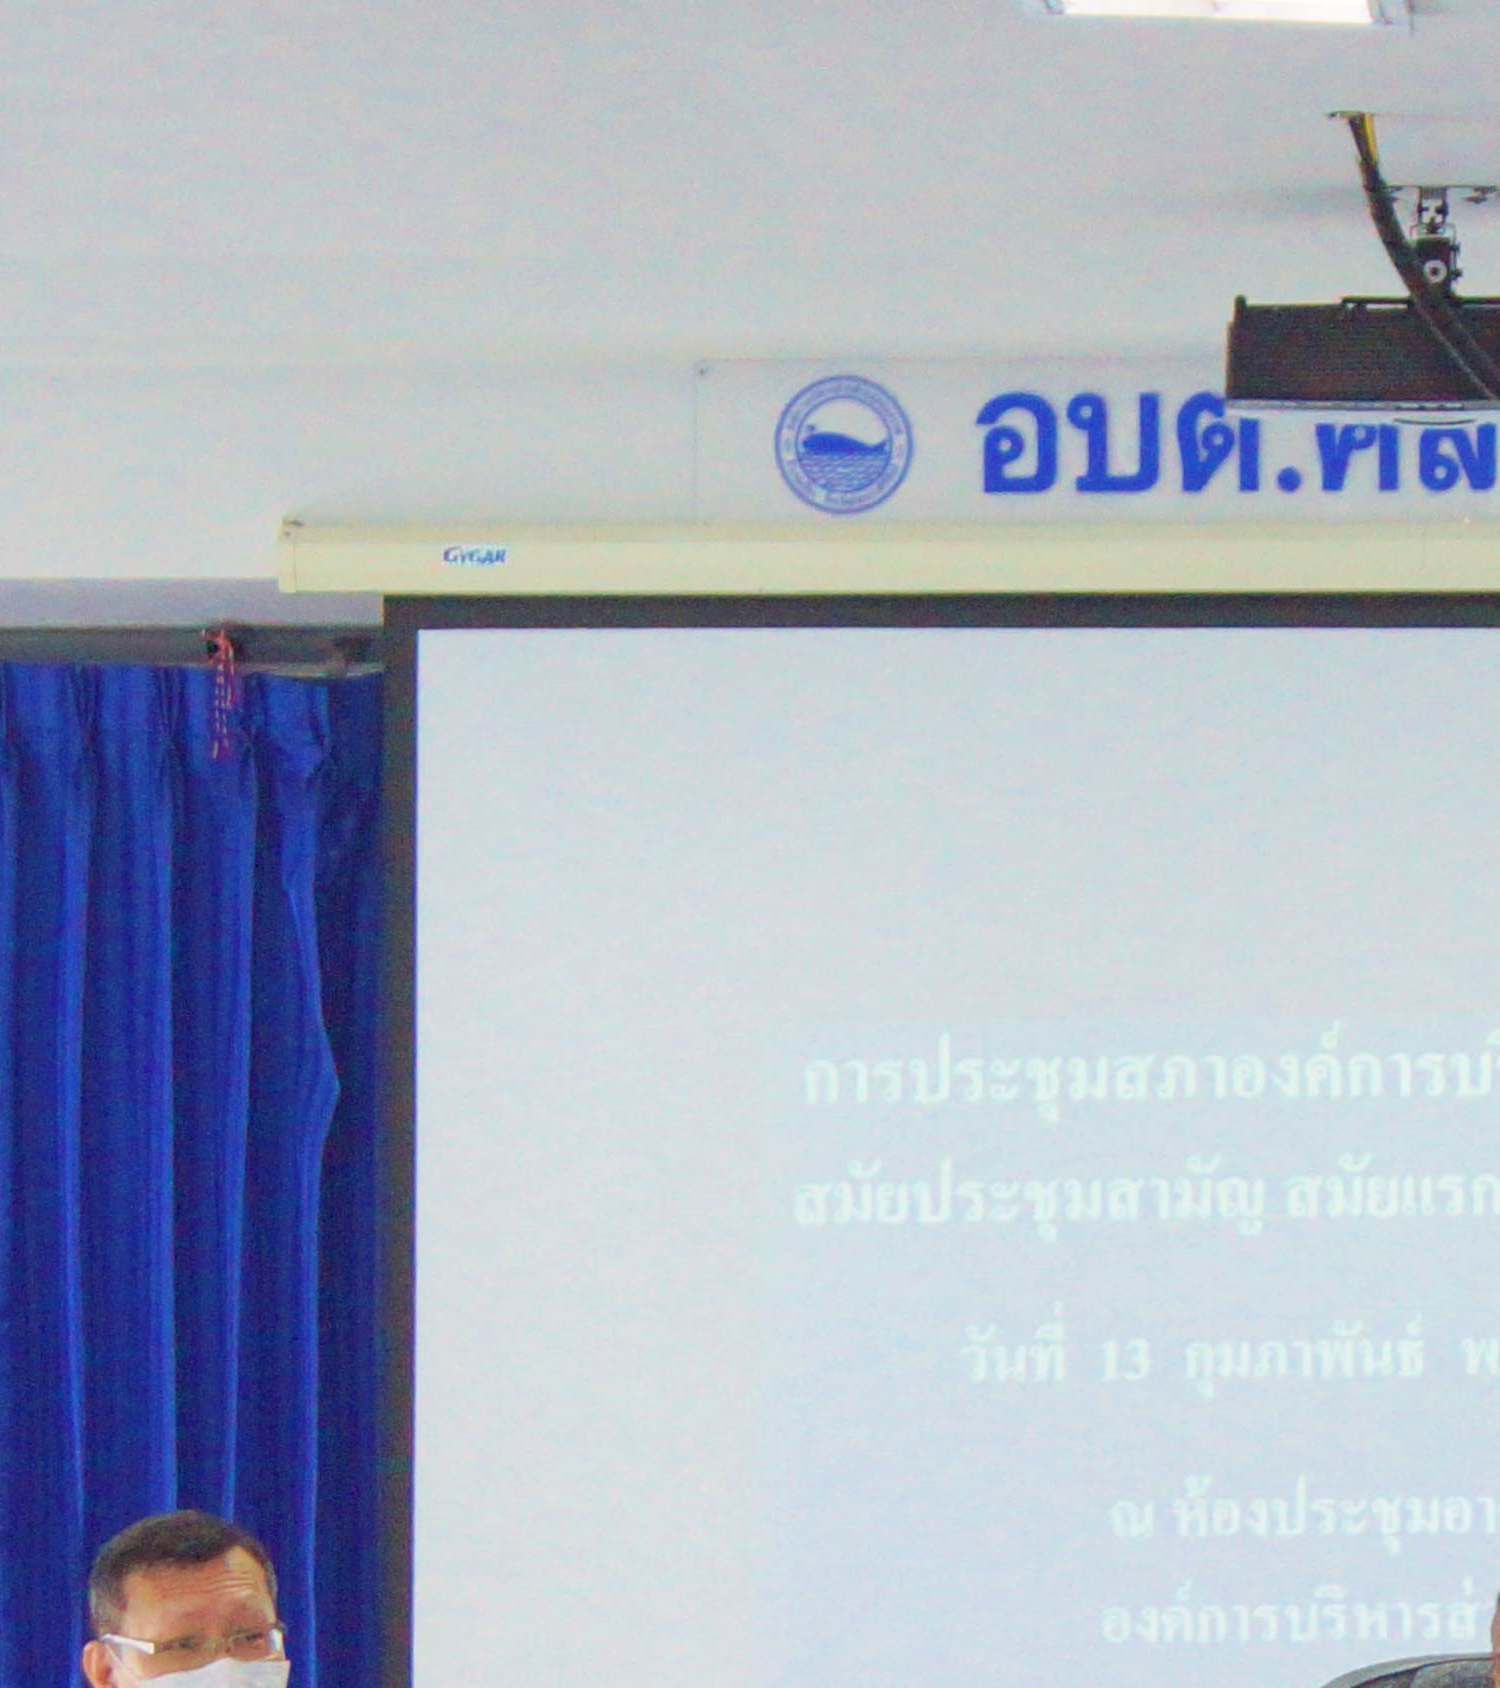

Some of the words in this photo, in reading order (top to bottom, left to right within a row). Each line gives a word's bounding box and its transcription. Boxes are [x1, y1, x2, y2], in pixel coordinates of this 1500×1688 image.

[792, 1153, 1266, 1243] สมัยประชุมสามัญ
[958, 1302, 1067, 1384] วันที่
[1100, 1337, 1153, 1382] 13
[1183, 1313, 1427, 1400] กุมภาพันธ์
[1108, 1498, 1156, 1539] ณ
